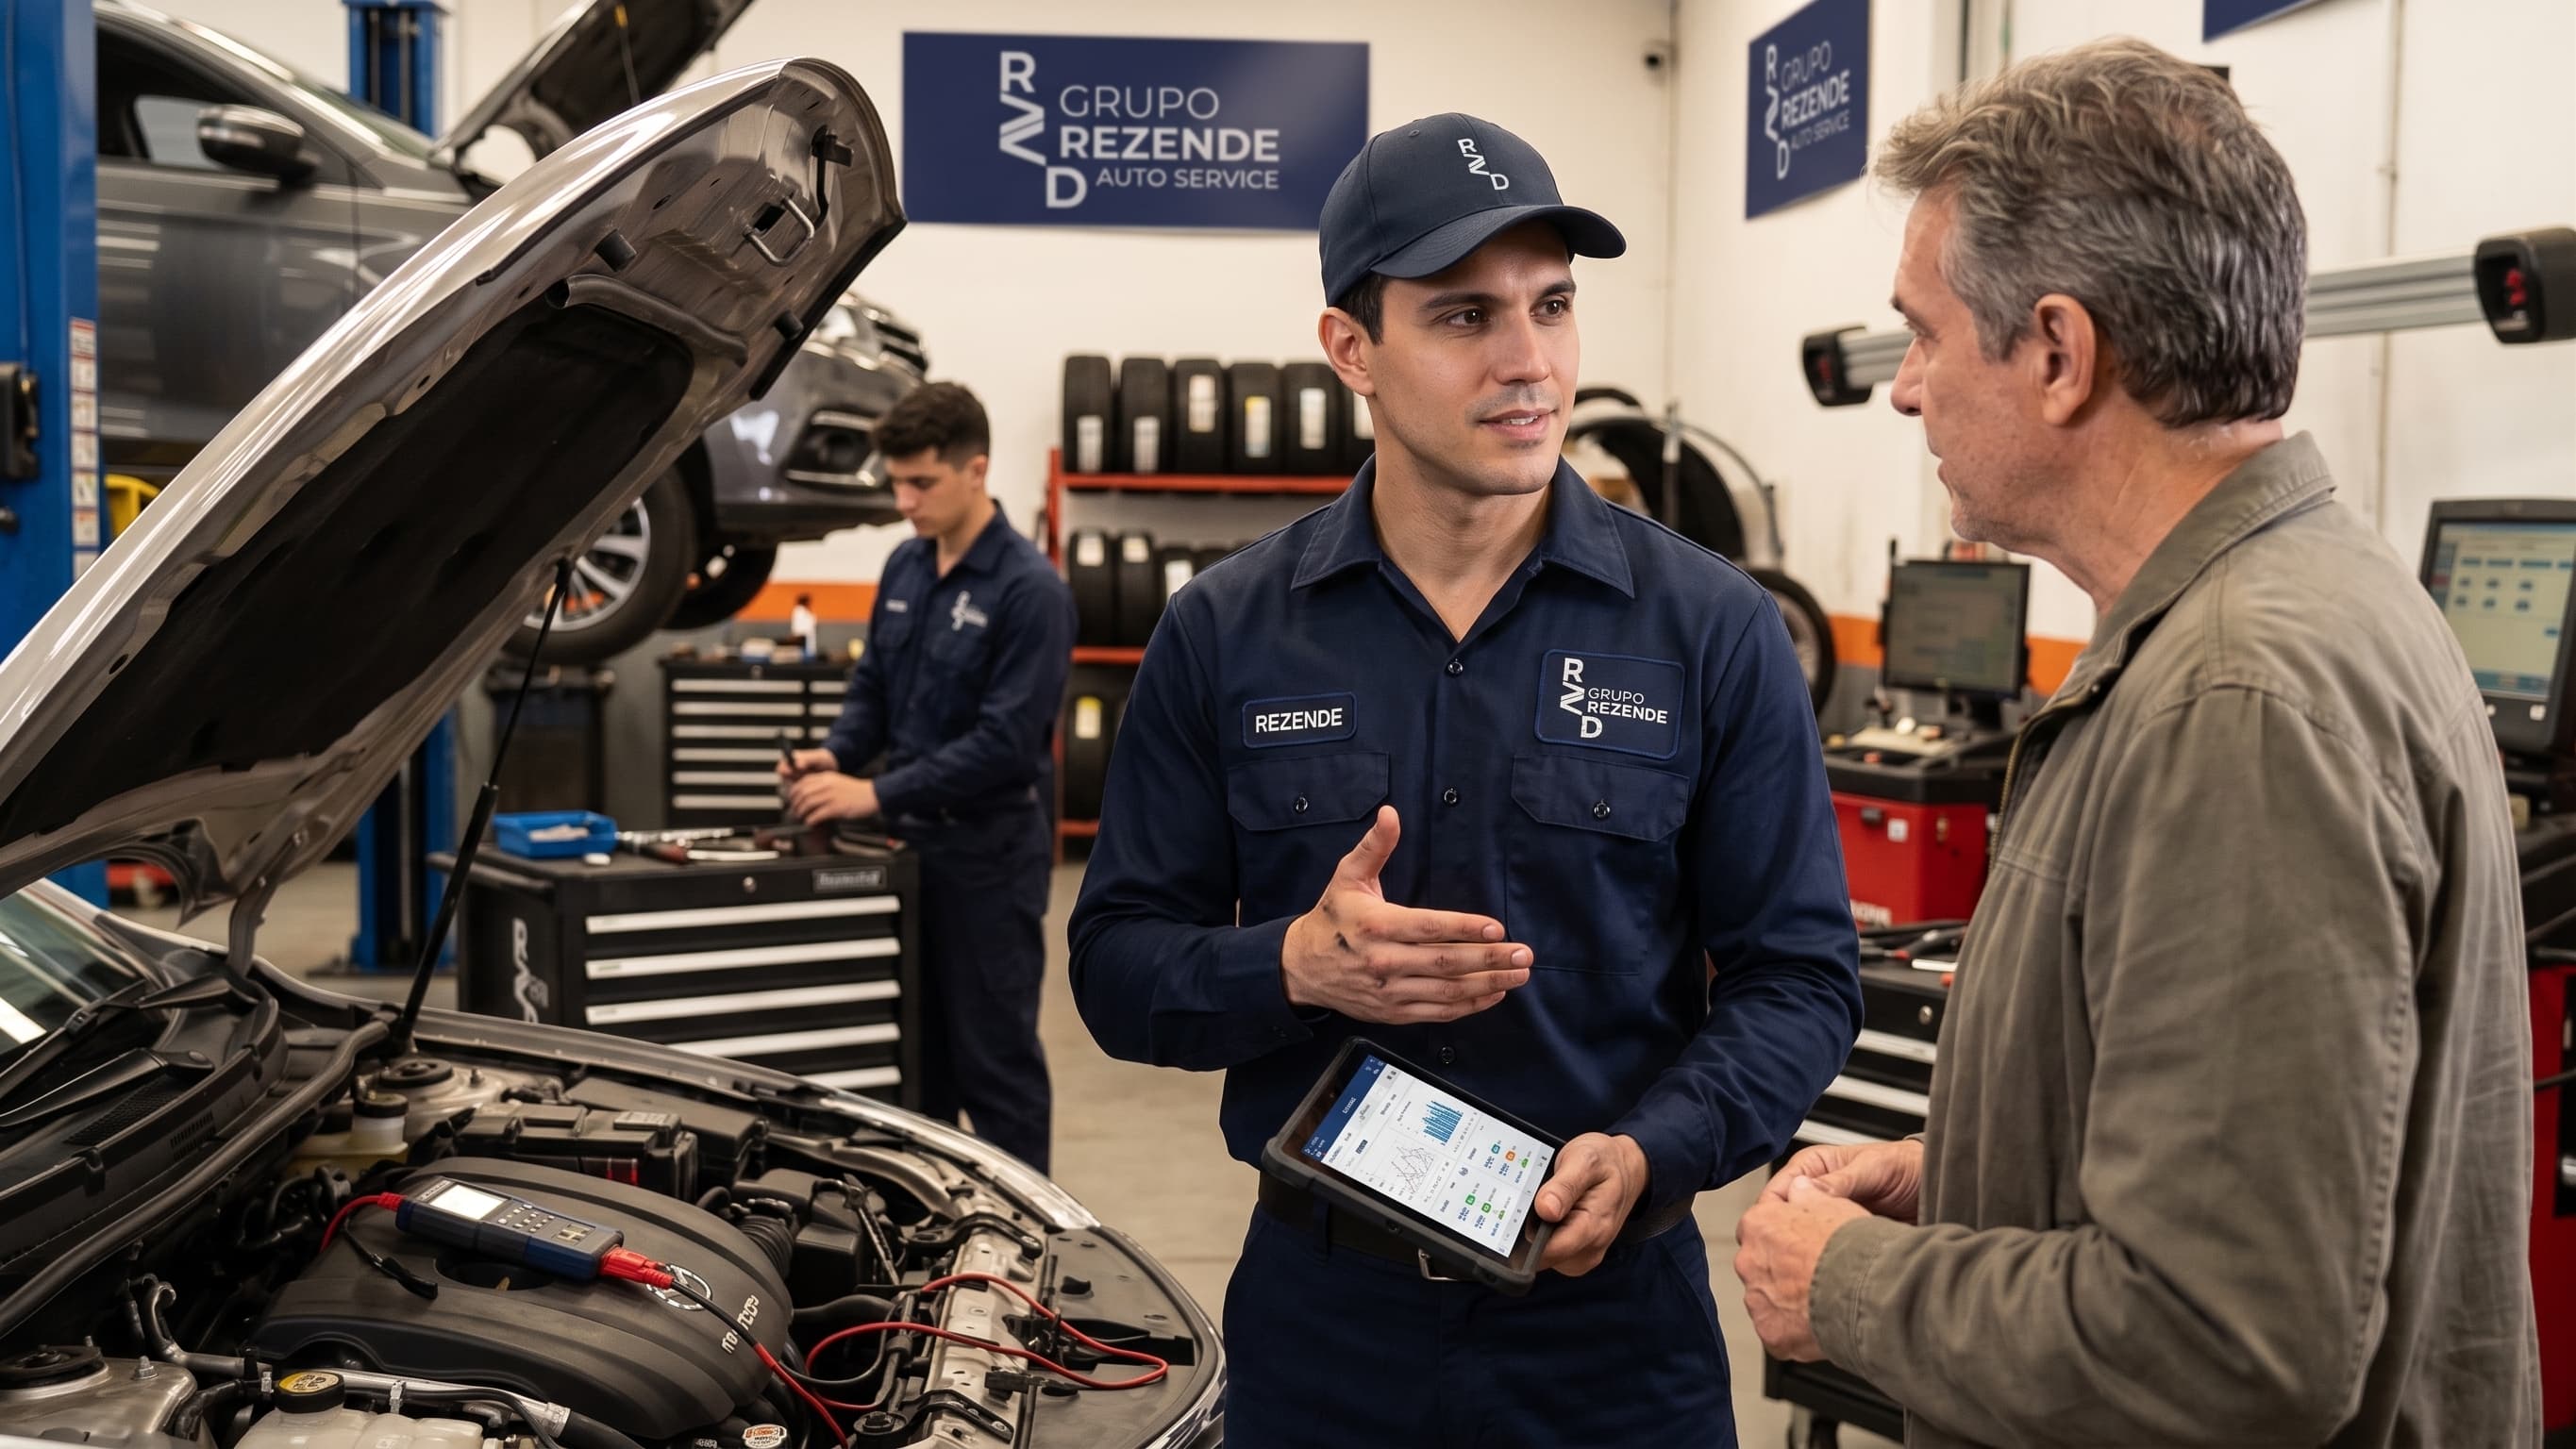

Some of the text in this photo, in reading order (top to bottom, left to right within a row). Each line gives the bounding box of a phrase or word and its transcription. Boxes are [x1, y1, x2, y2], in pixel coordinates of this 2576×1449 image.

[1781, 41, 1832, 92] GRUPO
[1059, 85, 1220, 120] GRUPO
[1781, 70, 1850, 130] REZENDE
[1059, 125, 1280, 162] REZENDE
[1791, 109, 1850, 151] AUTO SERVICE
[1096, 167, 1280, 190] AUTO SERVICE
[1587, 688, 1645, 705] GRUPO
[1587, 701, 1668, 724] REZENDE
[1254, 708, 1344, 733] REZENDE
